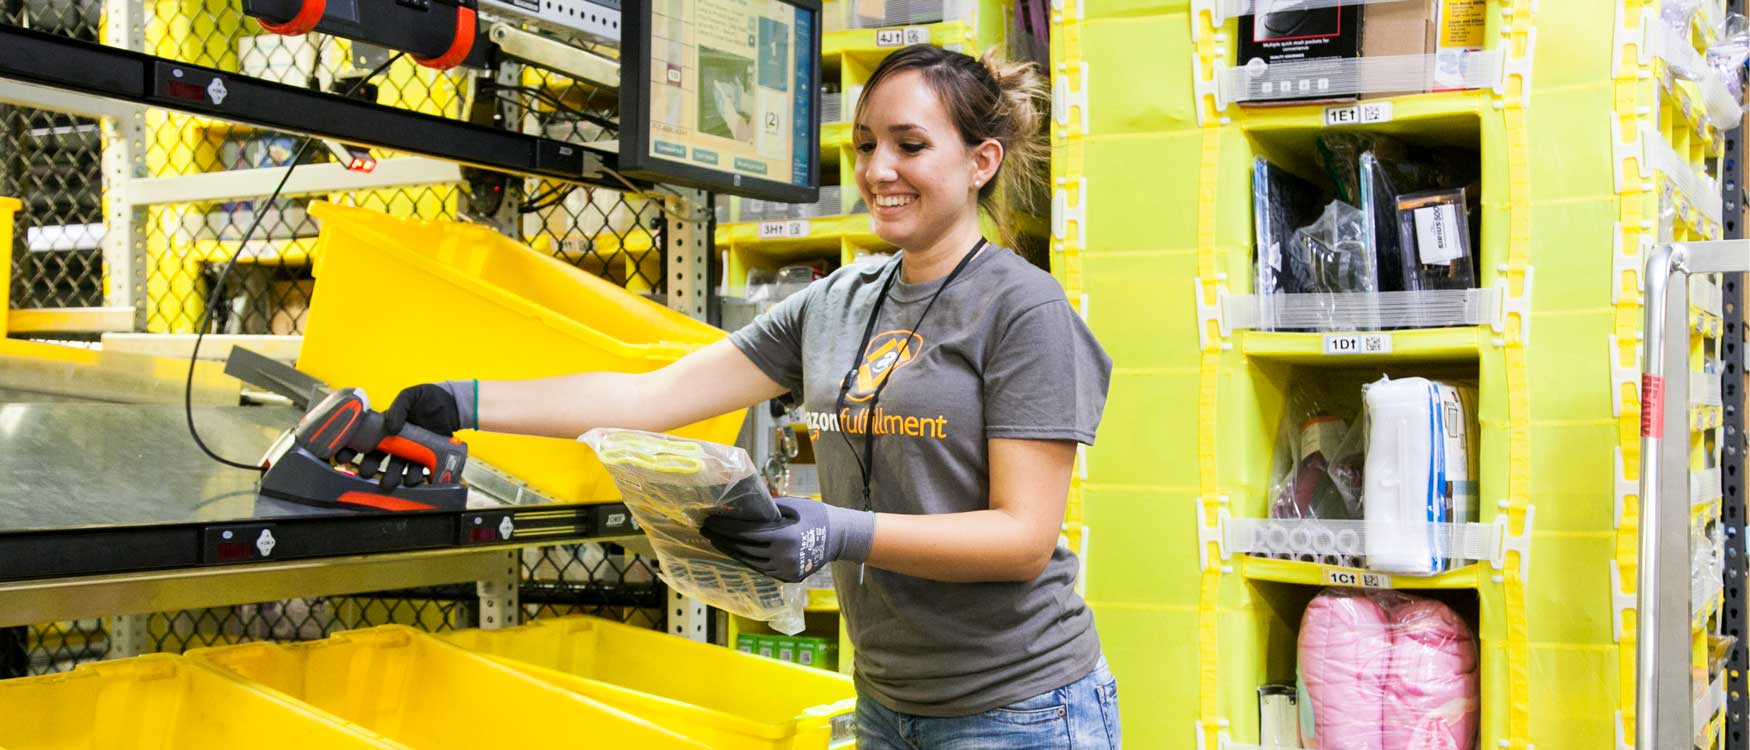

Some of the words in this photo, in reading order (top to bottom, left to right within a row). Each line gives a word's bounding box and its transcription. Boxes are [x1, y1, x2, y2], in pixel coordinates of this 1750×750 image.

[880, 32, 893, 43] 4J
[1331, 110, 1348, 121] 1E
[1435, 222, 1444, 249] SIRIUS
[1332, 339, 1350, 350] 1D
[1331, 573, 1348, 584] 1C
